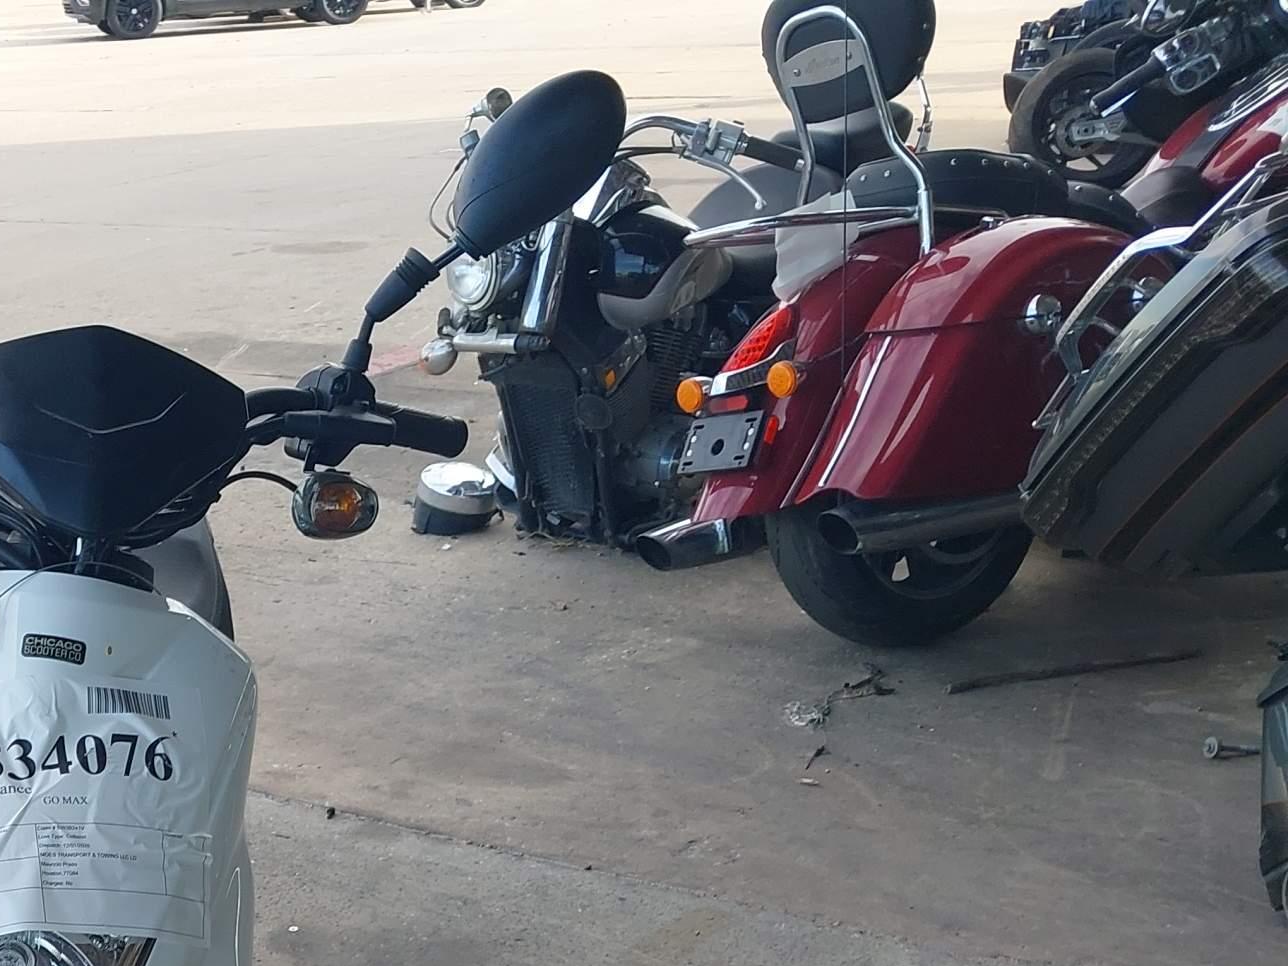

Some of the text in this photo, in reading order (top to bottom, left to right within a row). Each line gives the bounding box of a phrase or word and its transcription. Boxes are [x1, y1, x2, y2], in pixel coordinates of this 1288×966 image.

[24, 636, 83, 652] CHICAGO
[23, 645, 68, 659] SCOOTER
[43, 796, 60, 805] GO
[62, 796, 88, 805] MAX
